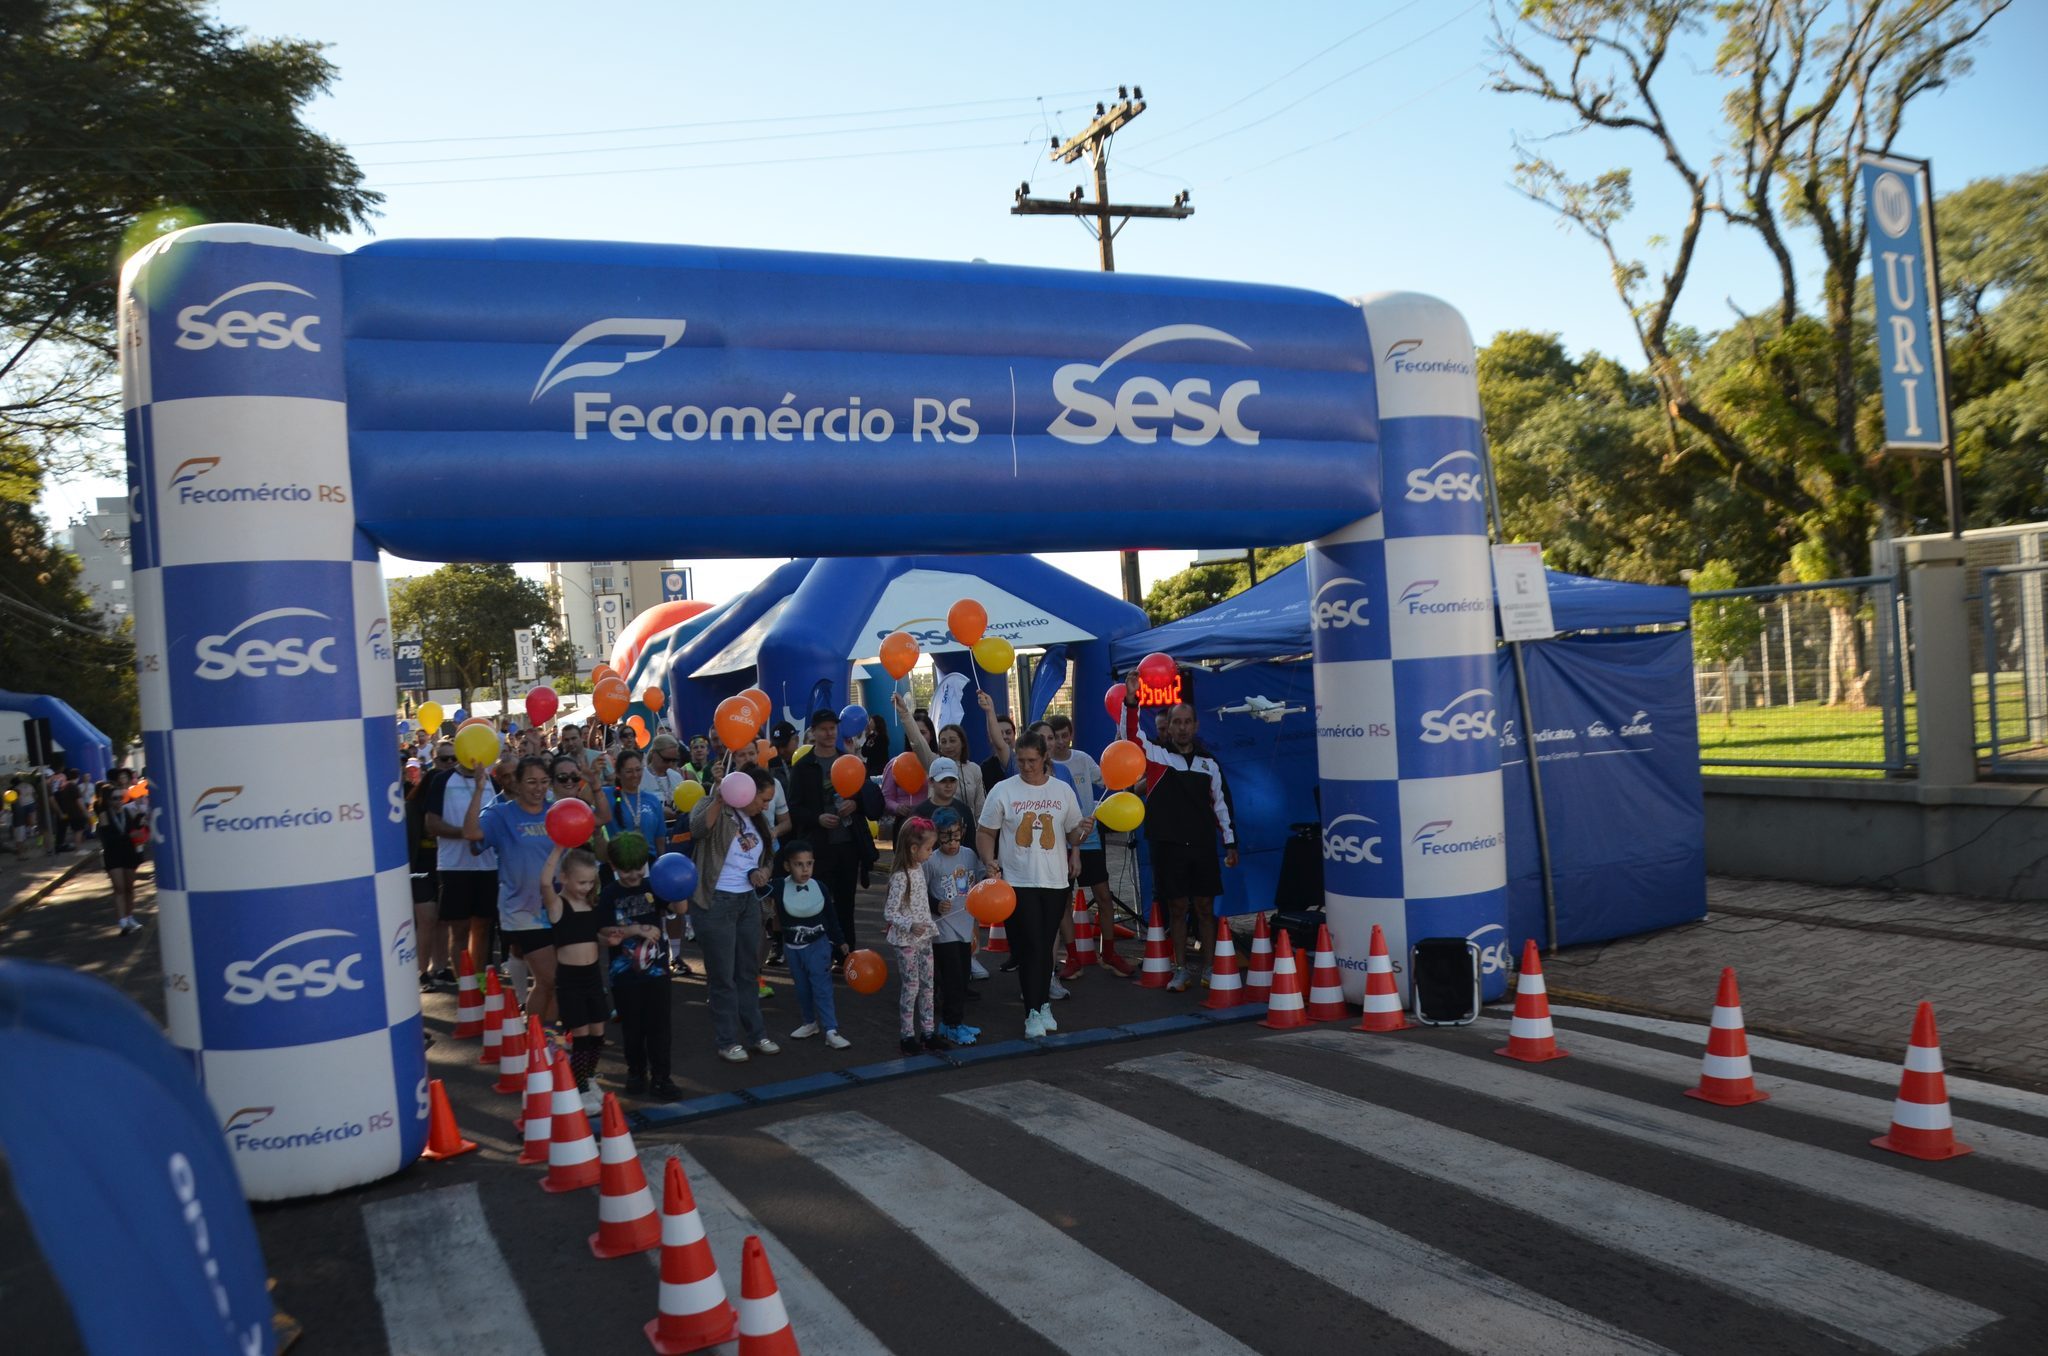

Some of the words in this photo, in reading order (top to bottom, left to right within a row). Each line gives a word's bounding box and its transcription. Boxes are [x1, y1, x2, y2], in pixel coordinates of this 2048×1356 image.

[175, 305, 321, 352] Sesc
[1881, 251, 1924, 437] URI
[573, 392, 894, 443] Fecomércio
[912, 397, 980, 444] RS
[1047, 363, 1260, 447] Sesc
[180, 483, 311, 504] Fecomércio
[318, 485, 346, 503] RS
[195, 635, 337, 680] Sesc
[520, 645, 530, 677] URI
[1369, 723, 1391, 737] RS
[203, 809, 333, 833] Fecomércio
[338, 803, 365, 822] RS
[224, 952, 364, 1006] Sesc
[235, 1121, 362, 1152] Fecomércio
[369, 1111, 393, 1131] RS
